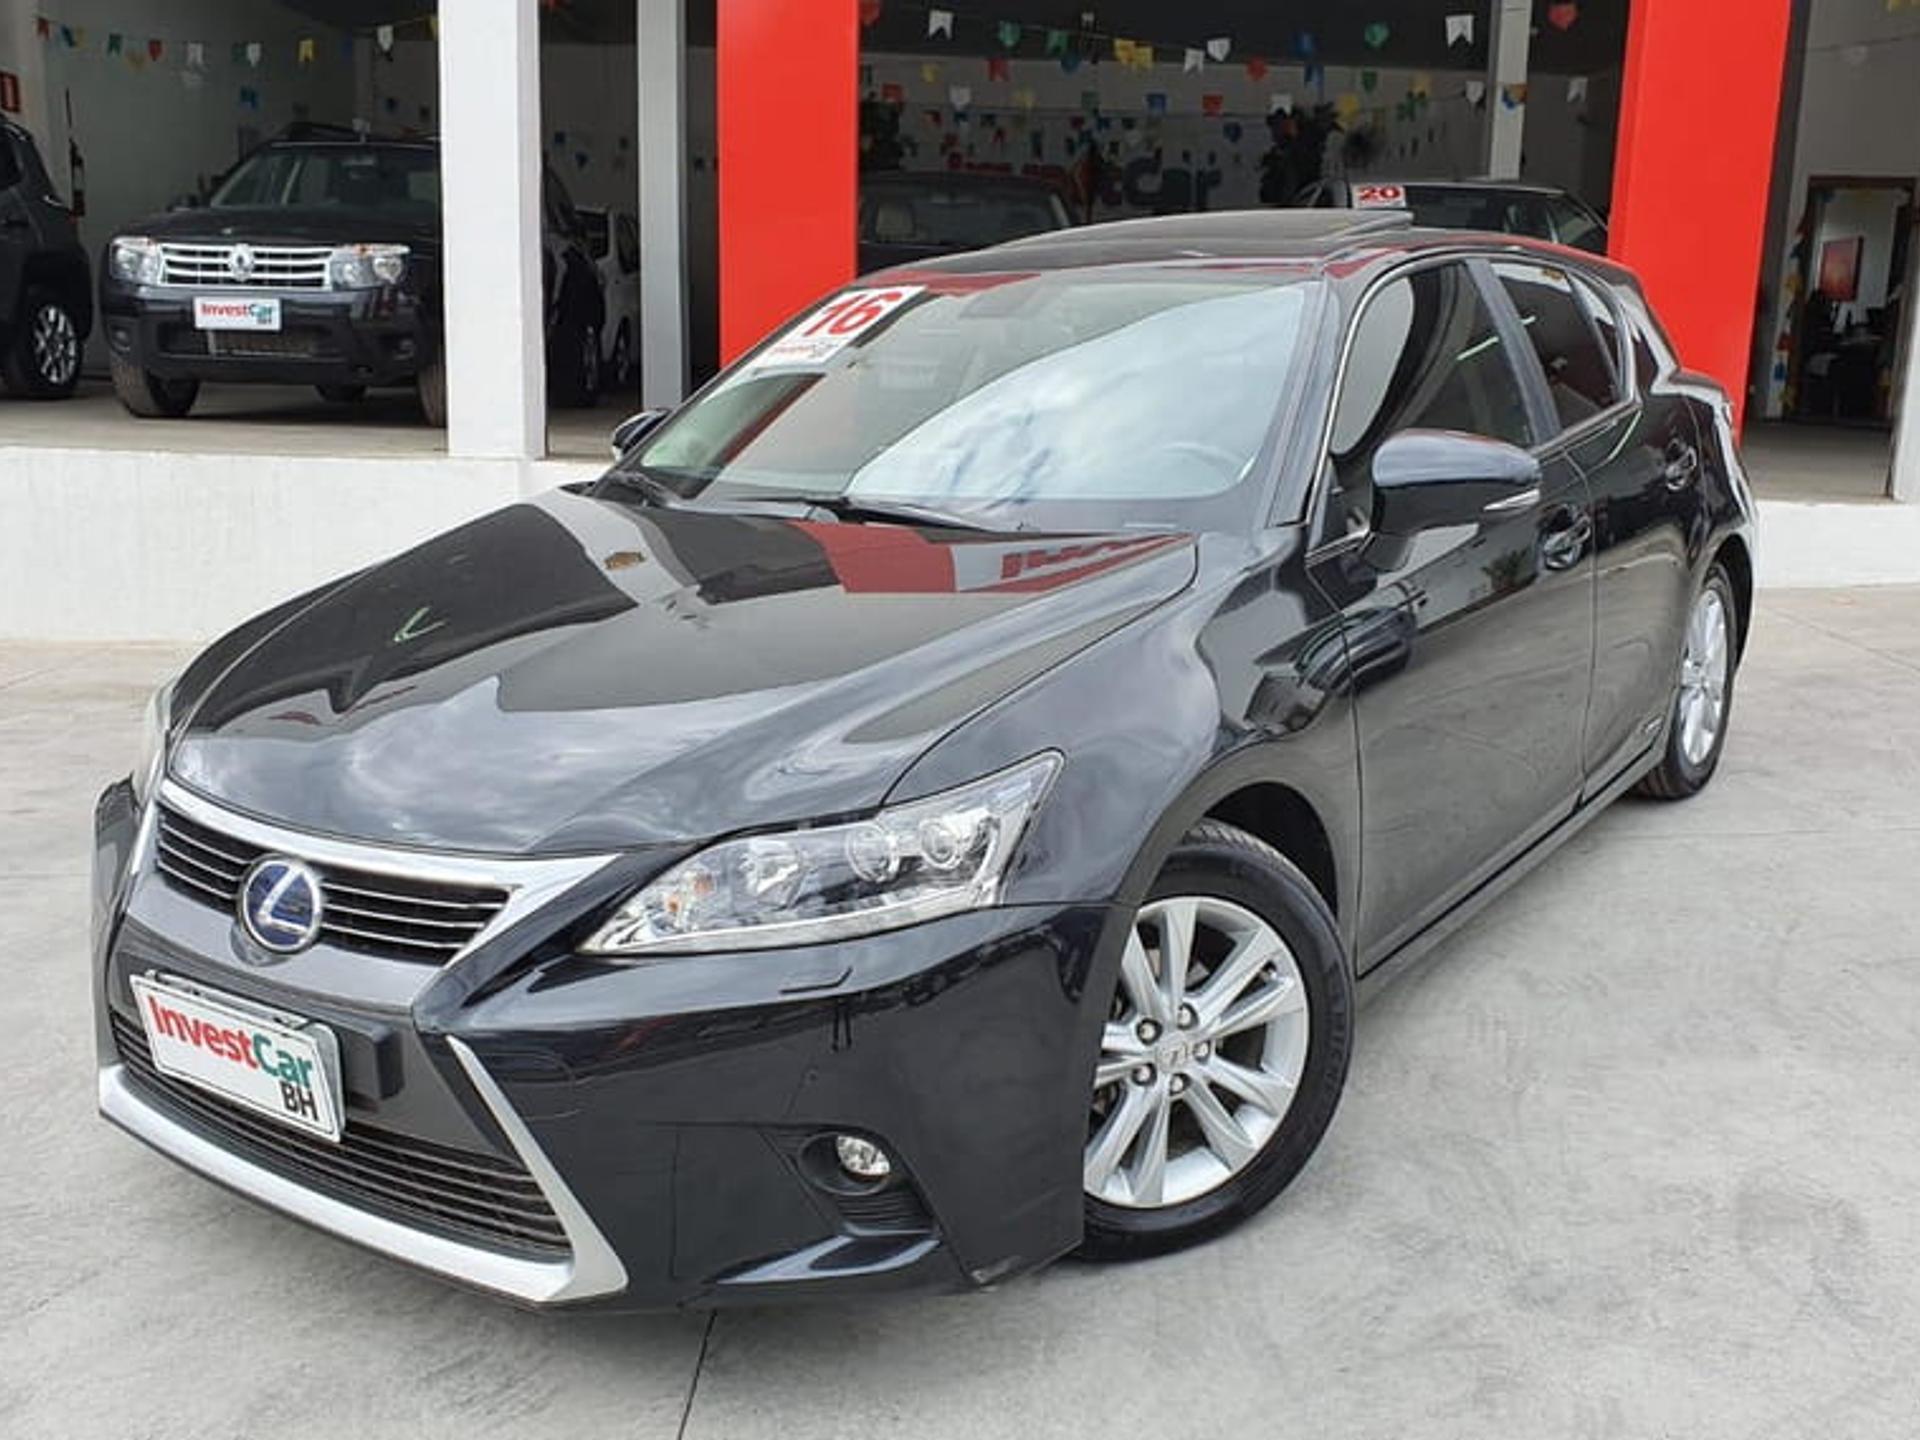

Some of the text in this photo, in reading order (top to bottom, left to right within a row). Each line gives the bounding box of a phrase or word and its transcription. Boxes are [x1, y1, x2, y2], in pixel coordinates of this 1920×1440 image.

[1358, 186, 1401, 200] 20
[803, 291, 904, 337] 16
[147, 994, 312, 1087] InvestCar
[279, 1081, 319, 1122] BH
